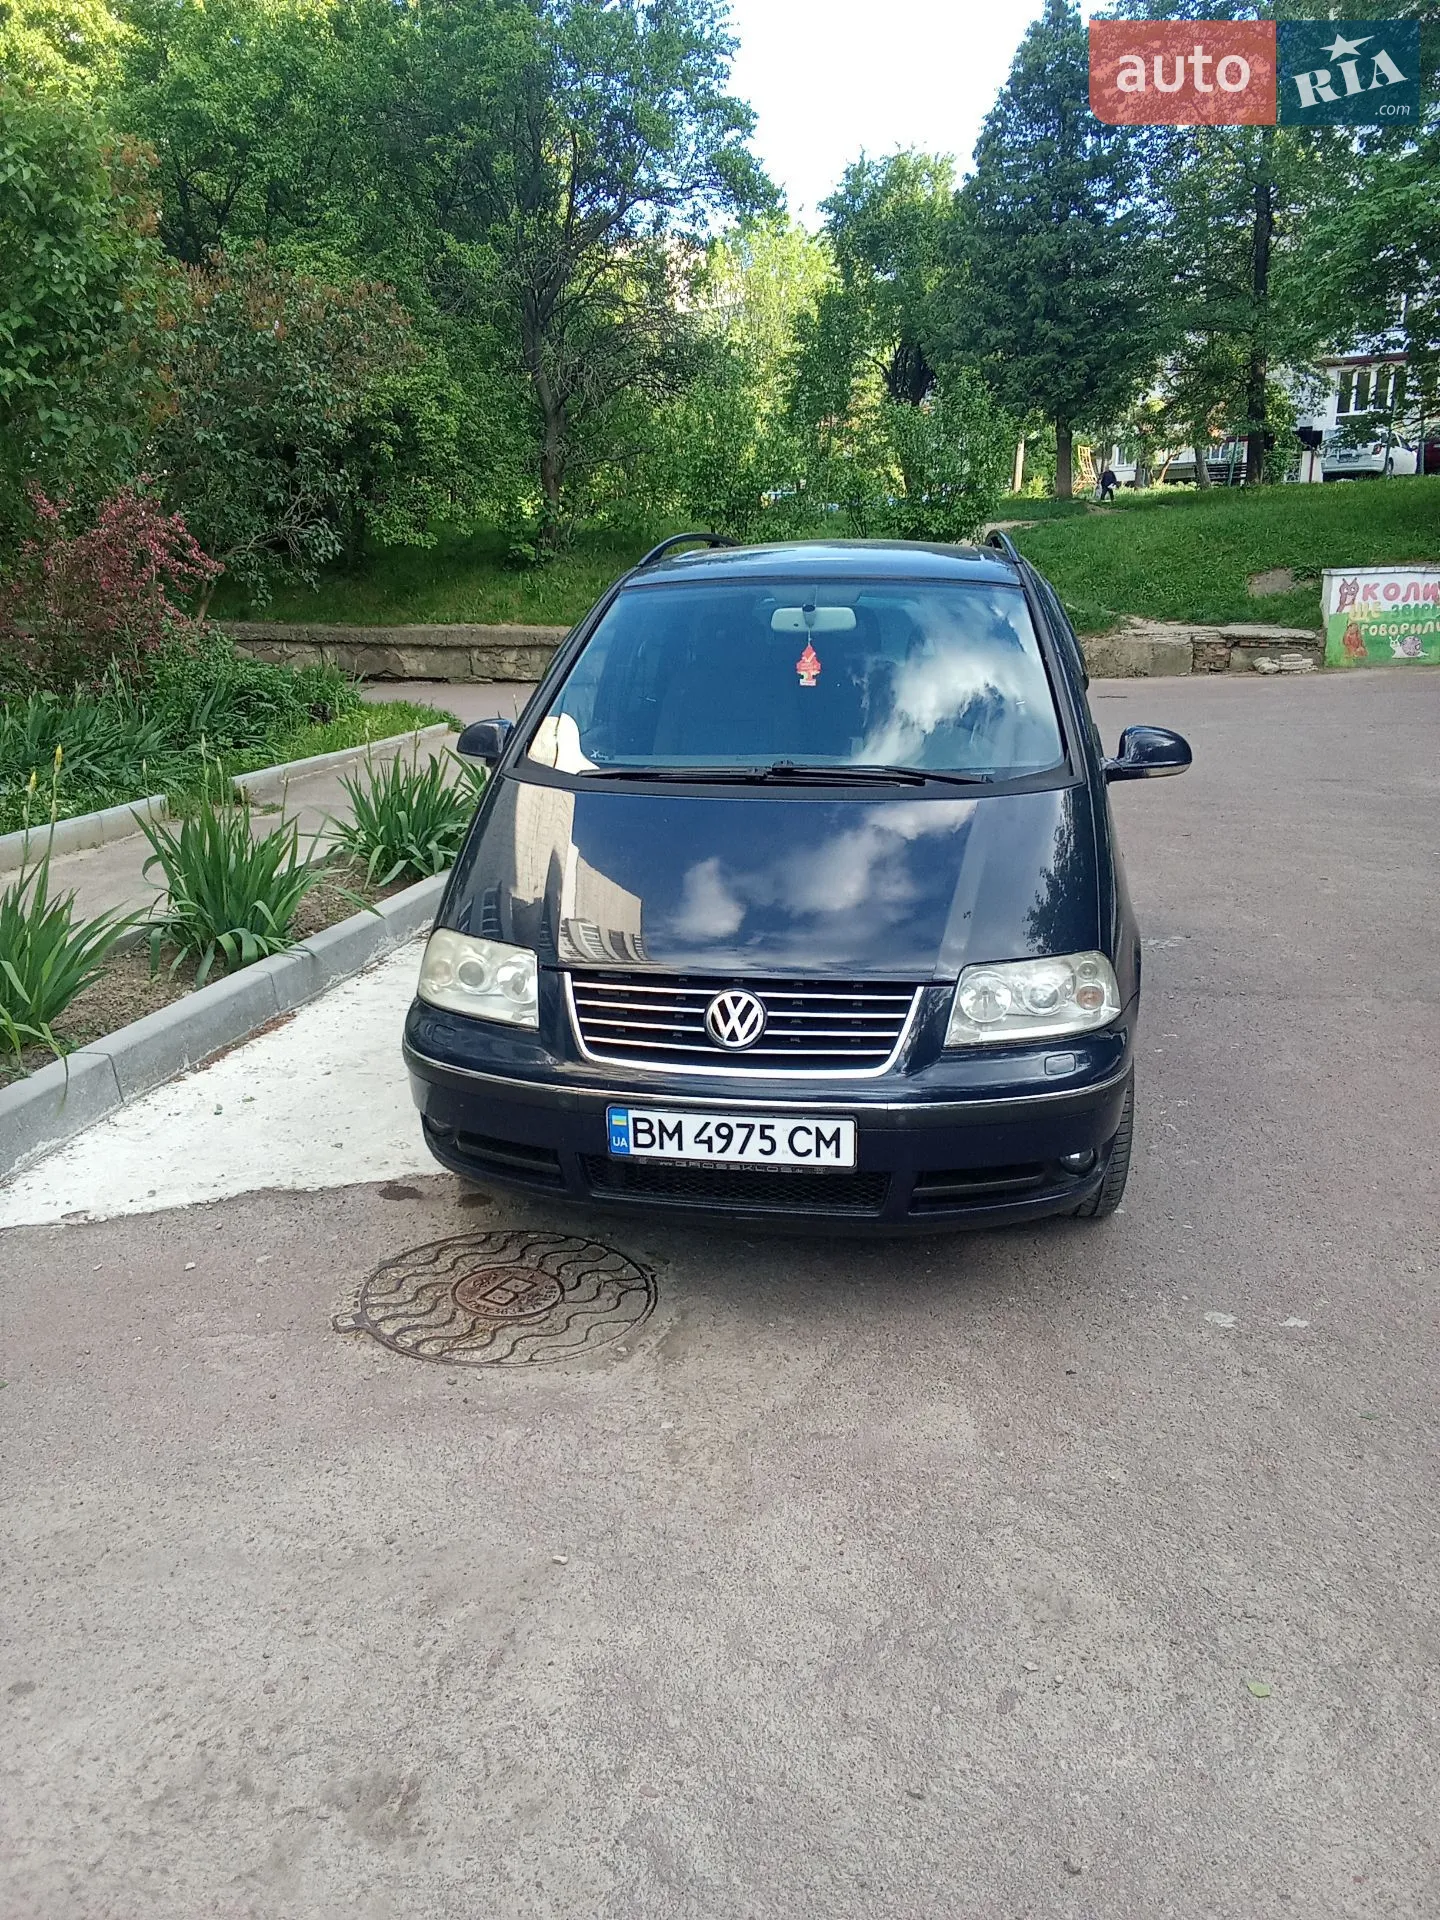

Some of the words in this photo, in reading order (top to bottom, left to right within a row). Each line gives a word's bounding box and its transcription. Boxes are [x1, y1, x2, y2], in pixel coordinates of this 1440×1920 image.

[612, 1136, 628, 1148] UA
[632, 1117, 684, 1151] BM
[694, 1121, 777, 1156] 4975
[787, 1125, 841, 1159] CM
